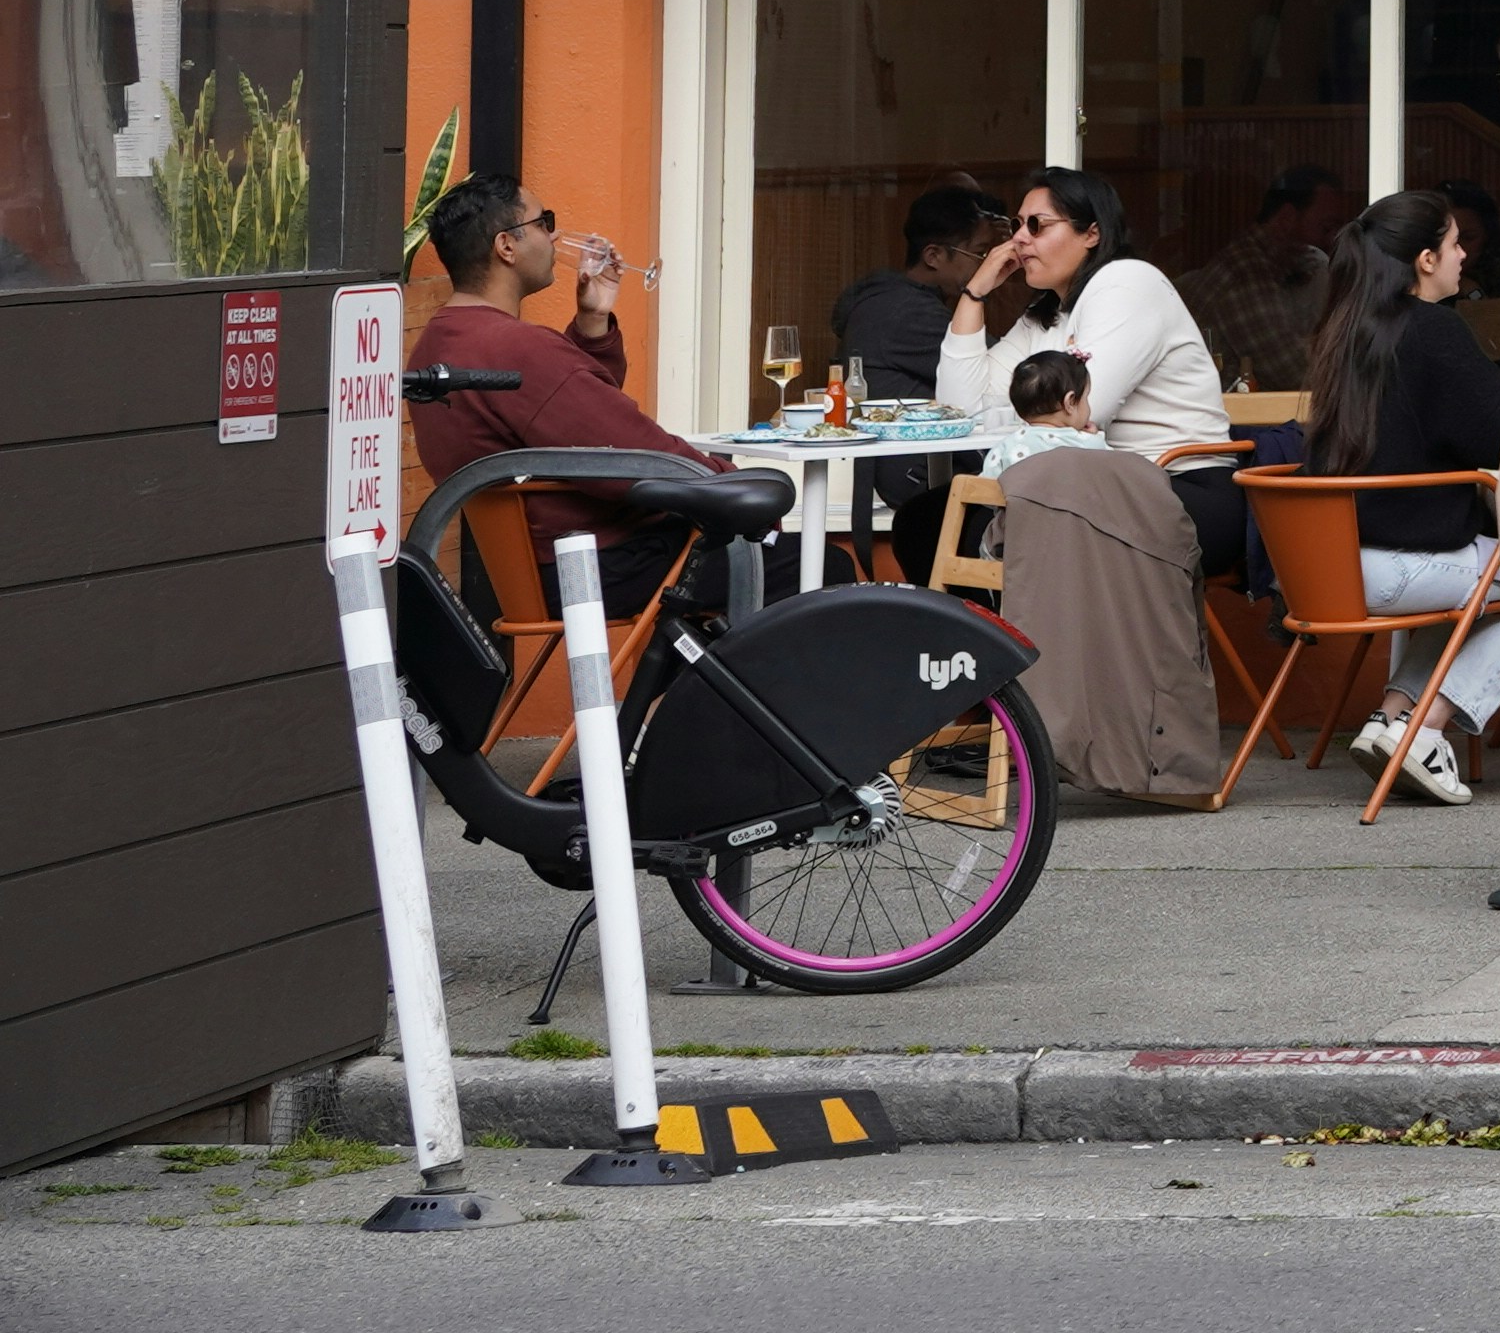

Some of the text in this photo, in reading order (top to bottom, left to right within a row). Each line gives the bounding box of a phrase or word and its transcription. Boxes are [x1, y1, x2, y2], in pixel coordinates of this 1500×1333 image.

[227, 307, 277, 324] KEEP CLEAR
[226, 328, 277, 345] AT ALL TIMES
[357, 317, 381, 364] NO
[339, 373, 395, 423] PARKING
[351, 434, 381, 470] FIRE
[348, 476, 381, 513] LANE
[919, 651, 977, 691] lyft
